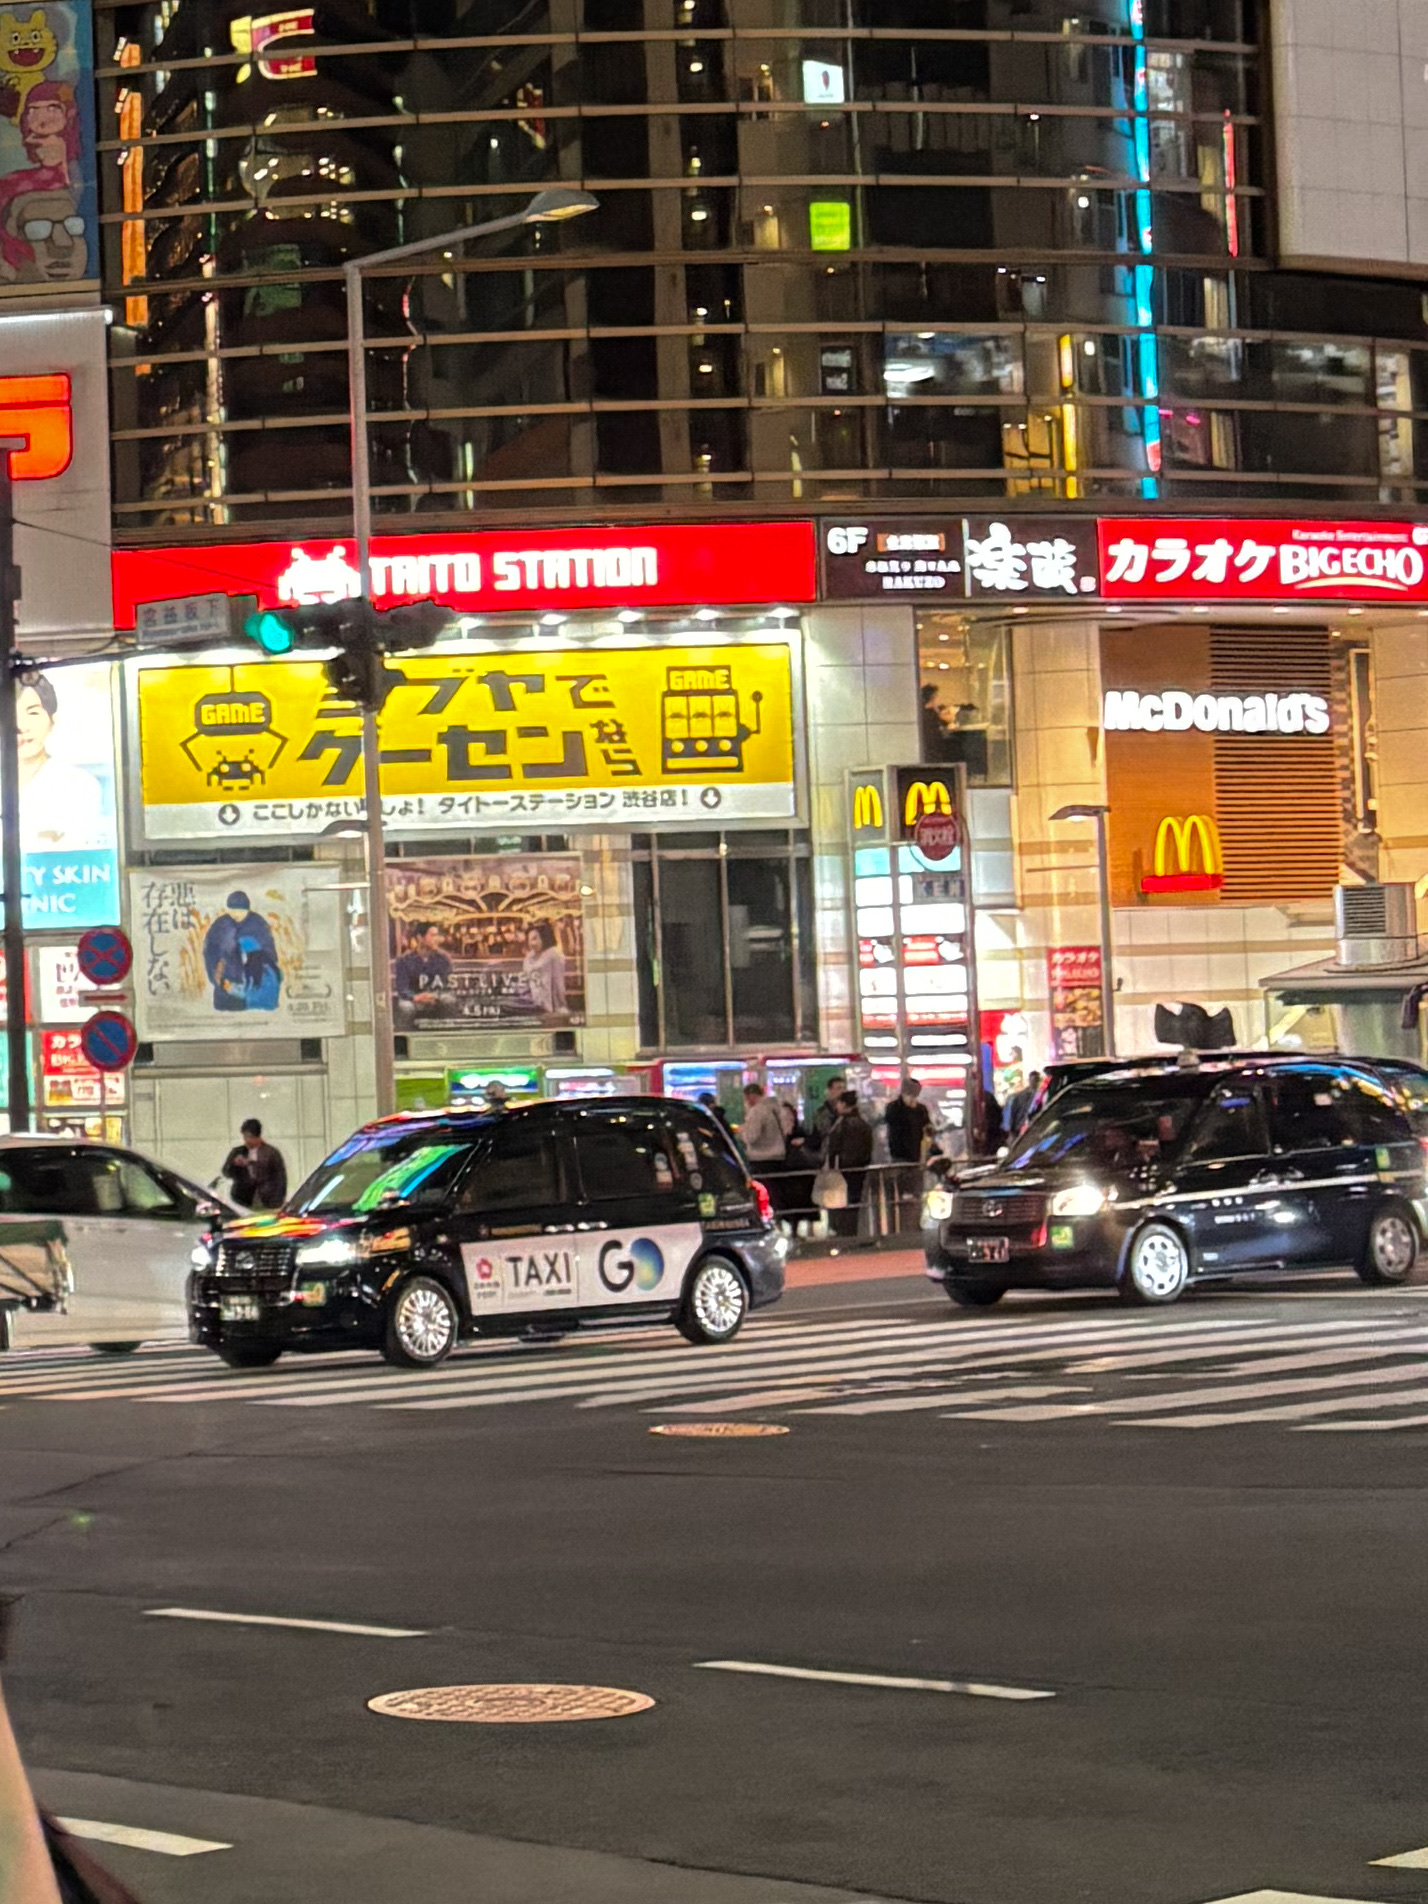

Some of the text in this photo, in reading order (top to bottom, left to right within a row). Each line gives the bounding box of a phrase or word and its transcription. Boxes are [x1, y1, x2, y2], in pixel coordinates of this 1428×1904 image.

[827, 526, 869, 555] 6F
[370, 546, 659, 598] TAITO STATION
[1105, 537, 1276, 583] カラオケ
[669, 667, 732, 691] GAME
[200, 701, 266, 726] GAME
[1103, 690, 1331, 734] McDonald's
[590, 718, 643, 776] なら
[252, 789, 689, 822] ここしかないしょ！ タイトーステーション 渋谷店！
[52, 864, 111, 885] SKIN
[141, 881, 171, 997] 存在しない
[418, 972, 542, 990] PAST LIVES
[505, 1251, 572, 1288] TAXI
[598, 1237, 665, 1293] GO
